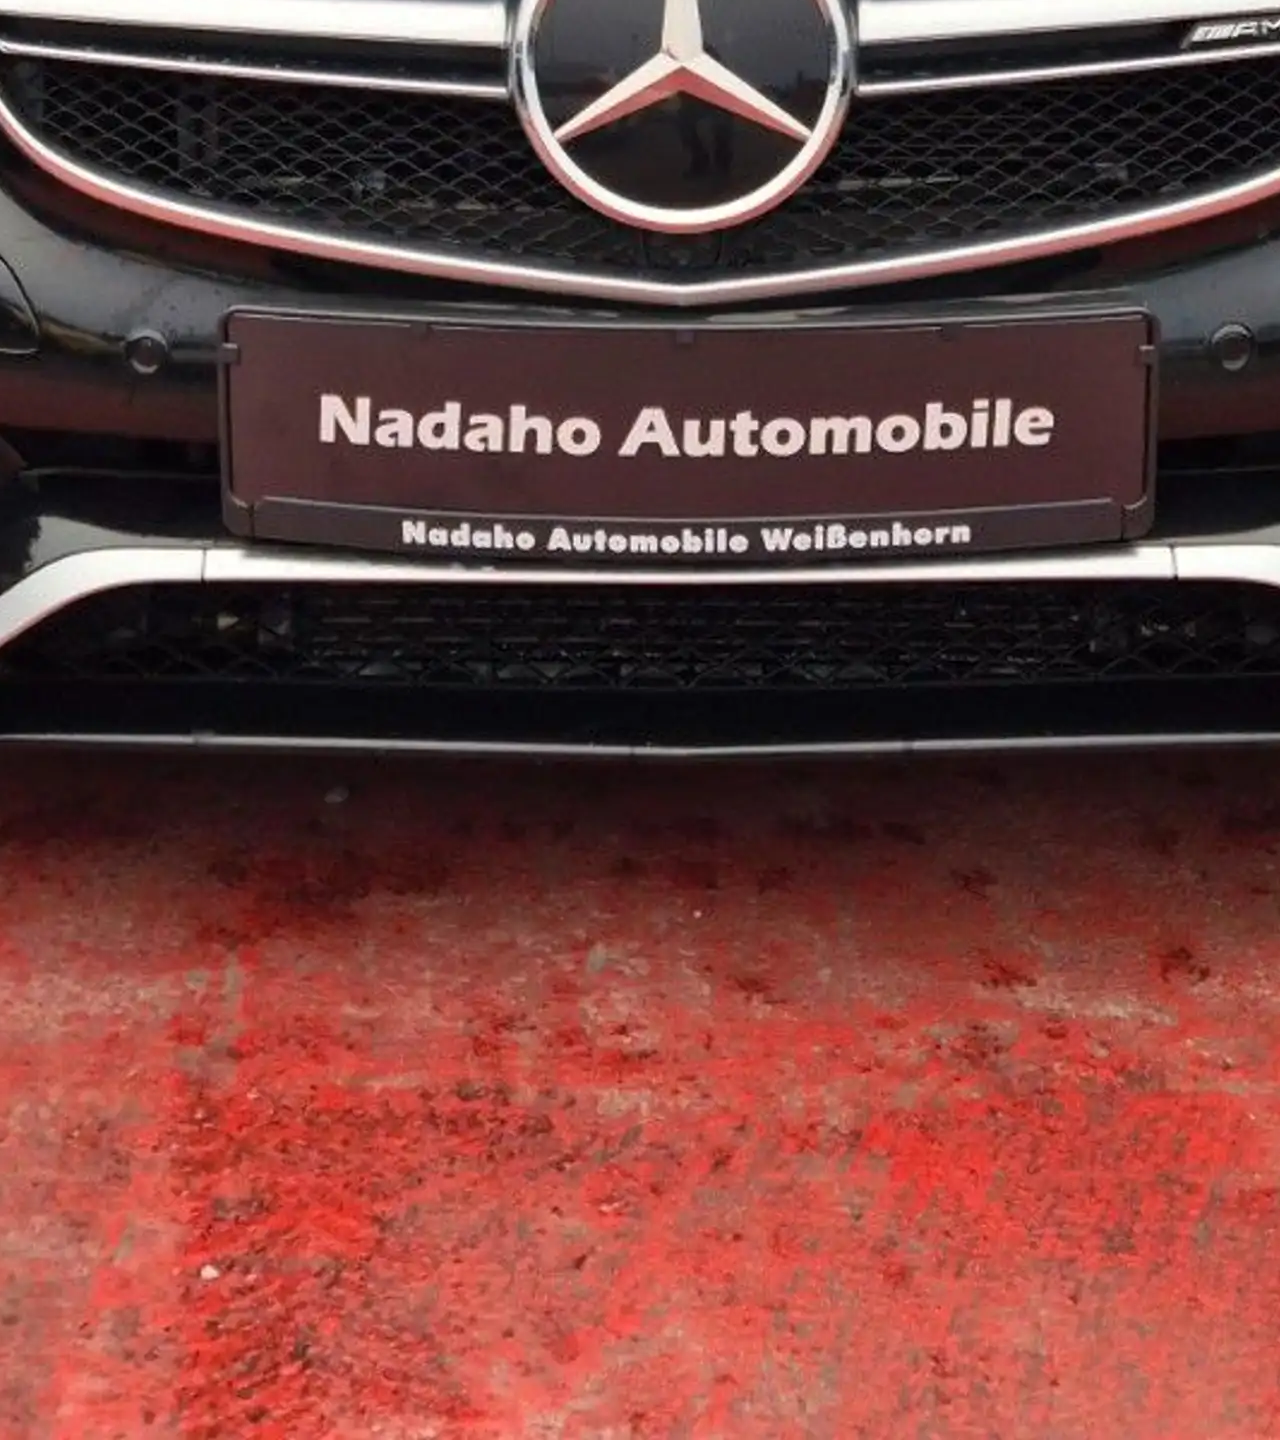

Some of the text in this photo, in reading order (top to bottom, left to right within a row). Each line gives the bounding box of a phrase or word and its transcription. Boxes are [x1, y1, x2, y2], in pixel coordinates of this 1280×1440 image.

[319, 393, 1055, 457] Nadaho Automobile
[401, 519, 972, 554] Nadaho Automobile Weißenhorn
